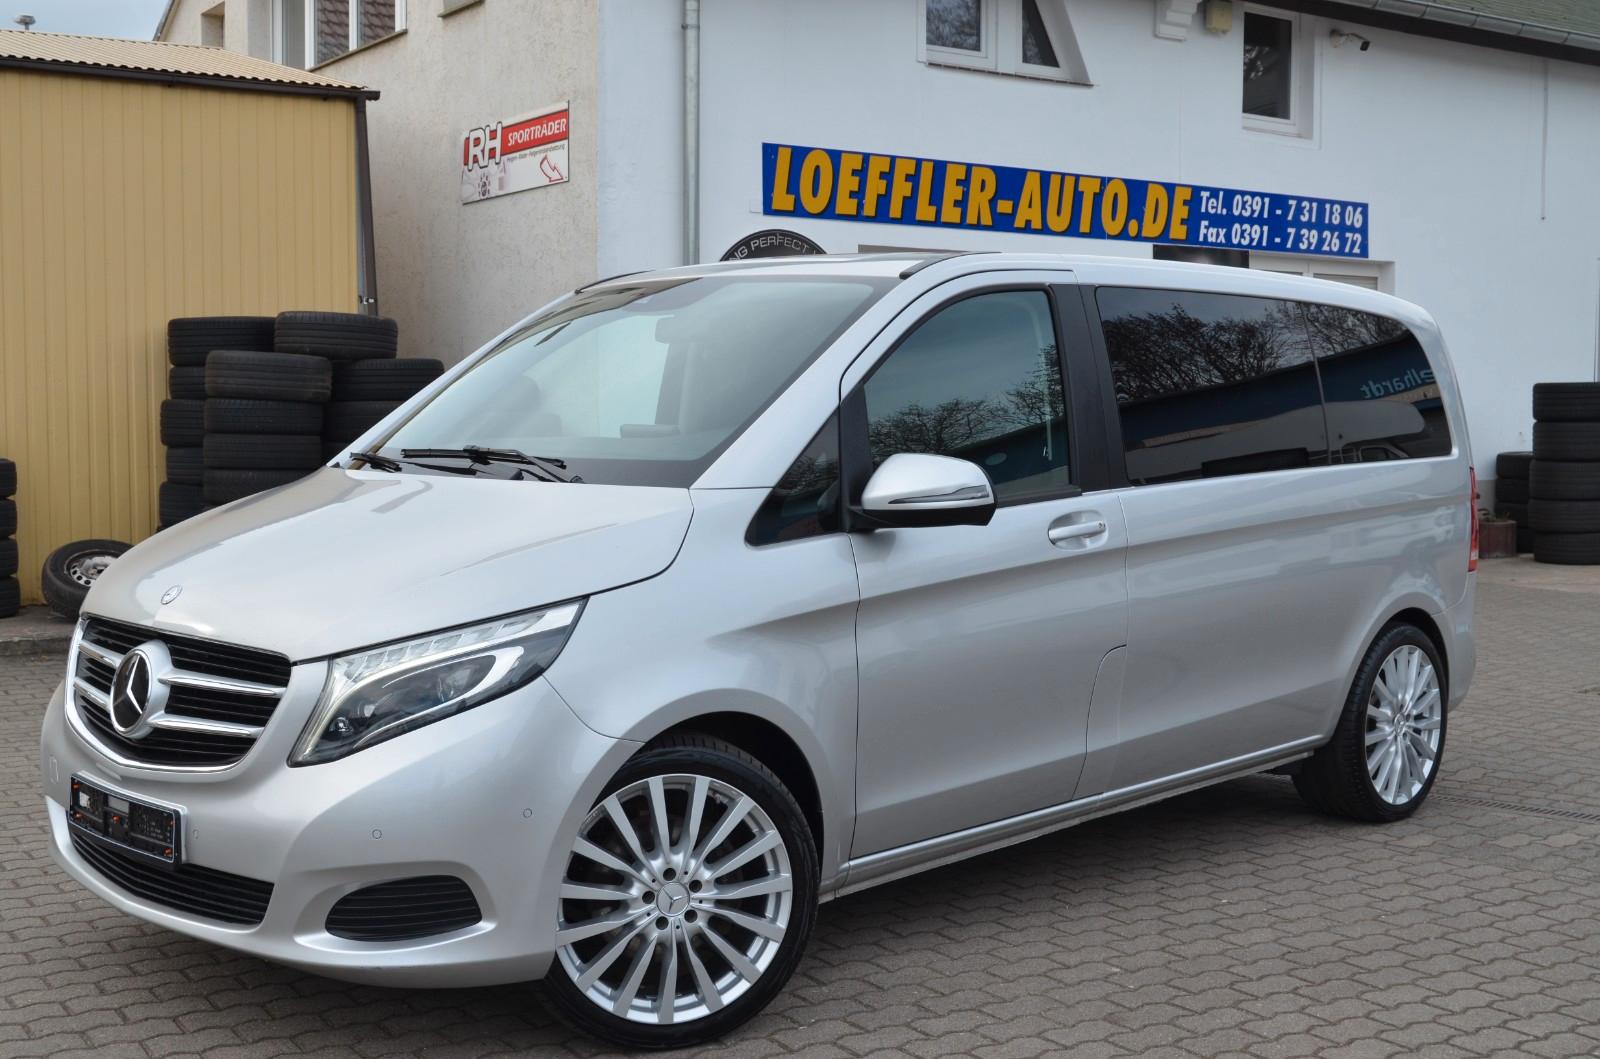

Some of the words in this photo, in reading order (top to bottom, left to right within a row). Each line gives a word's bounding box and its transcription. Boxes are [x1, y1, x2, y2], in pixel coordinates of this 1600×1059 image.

[467, 121, 503, 172] RH
[507, 117, 568, 147] SPORTRÄDER
[770, 146, 1193, 241] LOEFFLER-AUTO.DE
[1200, 191, 1227, 216] Tel.
[1232, 194, 1270, 219] 0391
[1287, 200, 1297, 221] 7
[1300, 201, 1318, 223] 31
[1324, 203, 1341, 226] 18
[1345, 205, 1363, 229] 06
[750, 233, 810, 253] PERFECT
[1199, 220, 1226, 244] Fax
[1231, 223, 1269, 247] 0391
[1286, 228, 1296, 249] 7
[1299, 228, 1318, 251] 39
[1322, 231, 1340, 253] 26
[1344, 232, 1362, 254] 72
